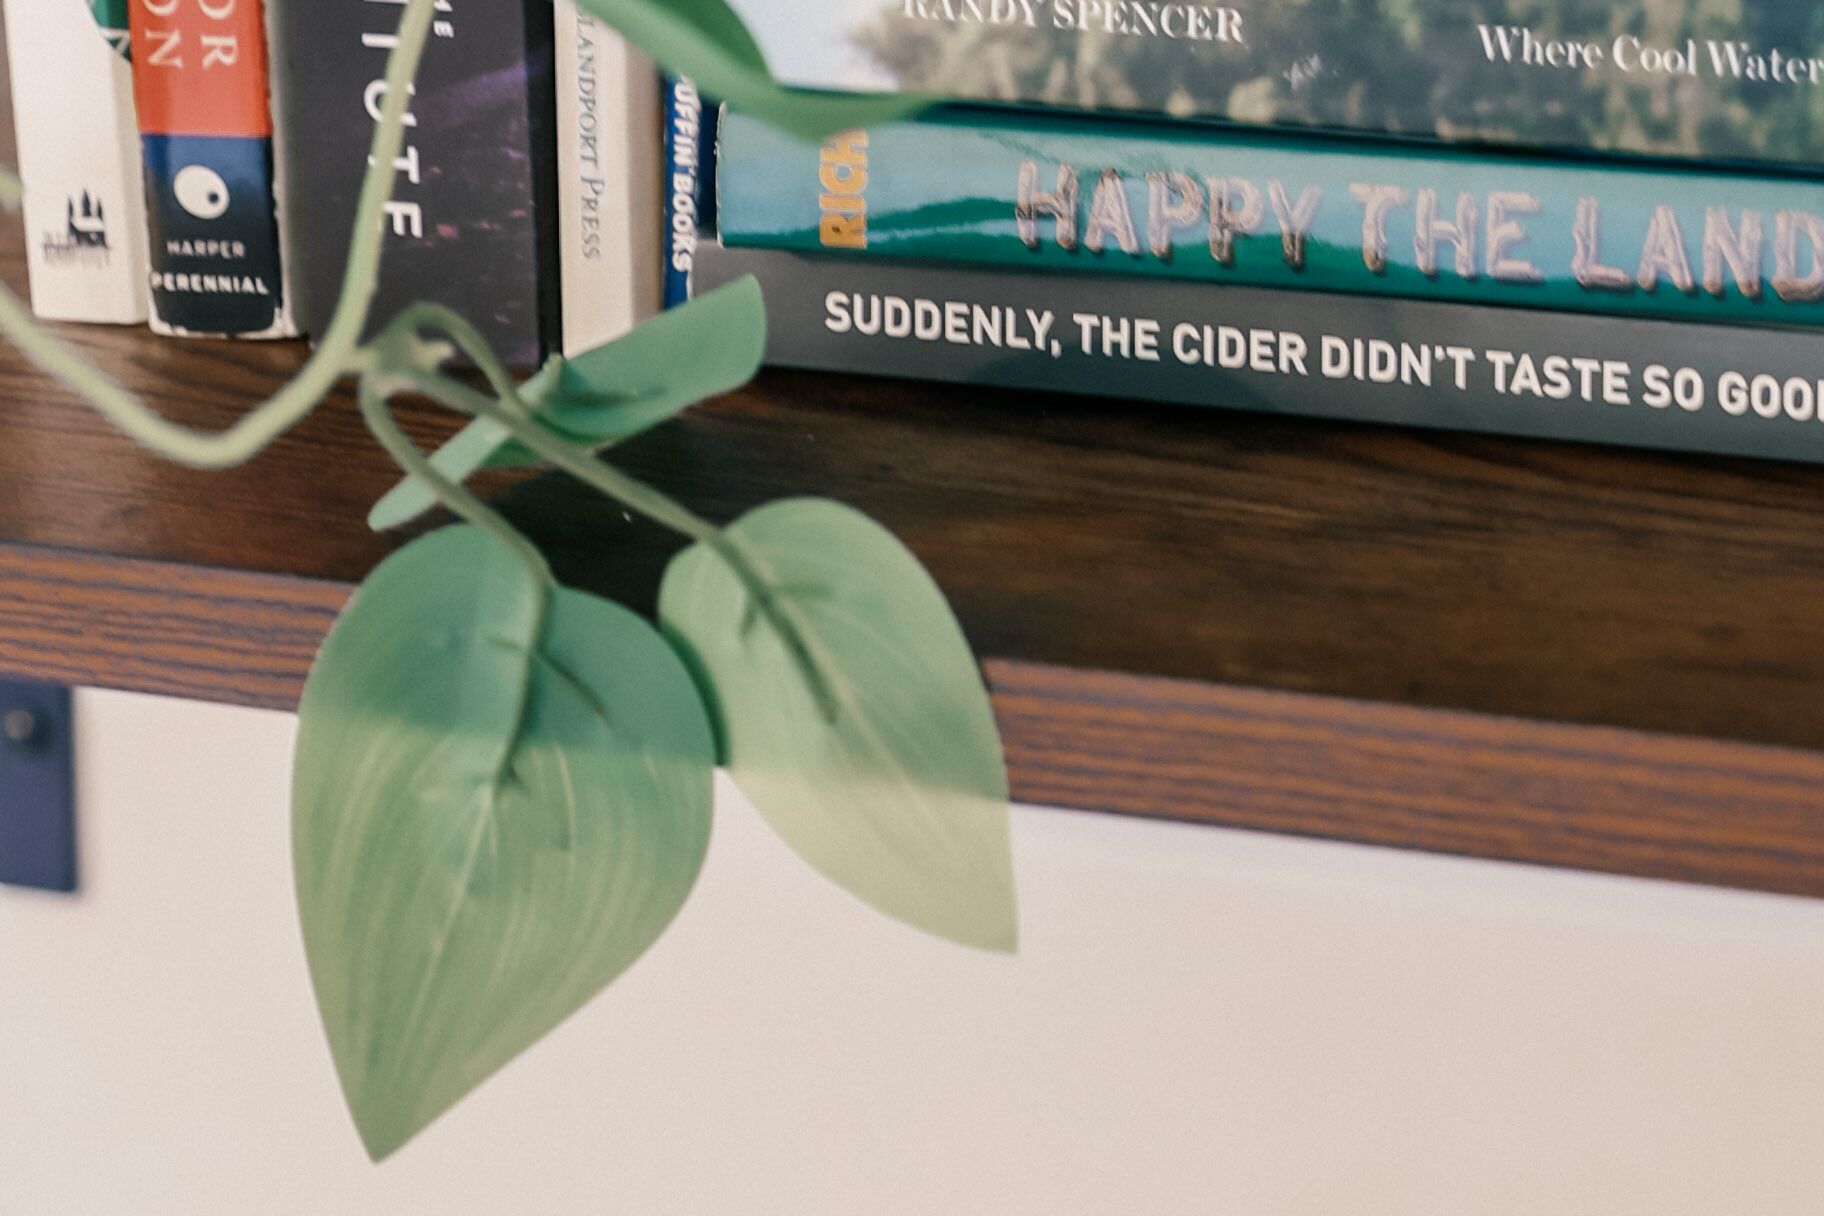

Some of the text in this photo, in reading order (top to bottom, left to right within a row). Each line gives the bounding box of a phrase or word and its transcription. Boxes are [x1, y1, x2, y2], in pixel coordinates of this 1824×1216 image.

[1478, 24, 1602, 69] Where
[1613, 34, 1697, 77] Cool
[671, 74, 701, 274] UFFIN BOOKS
[167, 240, 246, 259] HARPER
[1015, 159, 1323, 270] HAPPY
[1349, 182, 1543, 279] THE
[152, 273, 269, 296] PERENNIAL
[824, 291, 1062, 359] SUDDENLY,
[1073, 312, 1161, 362] THE
[1172, 322, 1308, 376] CIDER
[1320, 334, 1476, 390] DIDN'T
[1485, 349, 1632, 406] TASTE
[1641, 364, 1705, 412] SO
